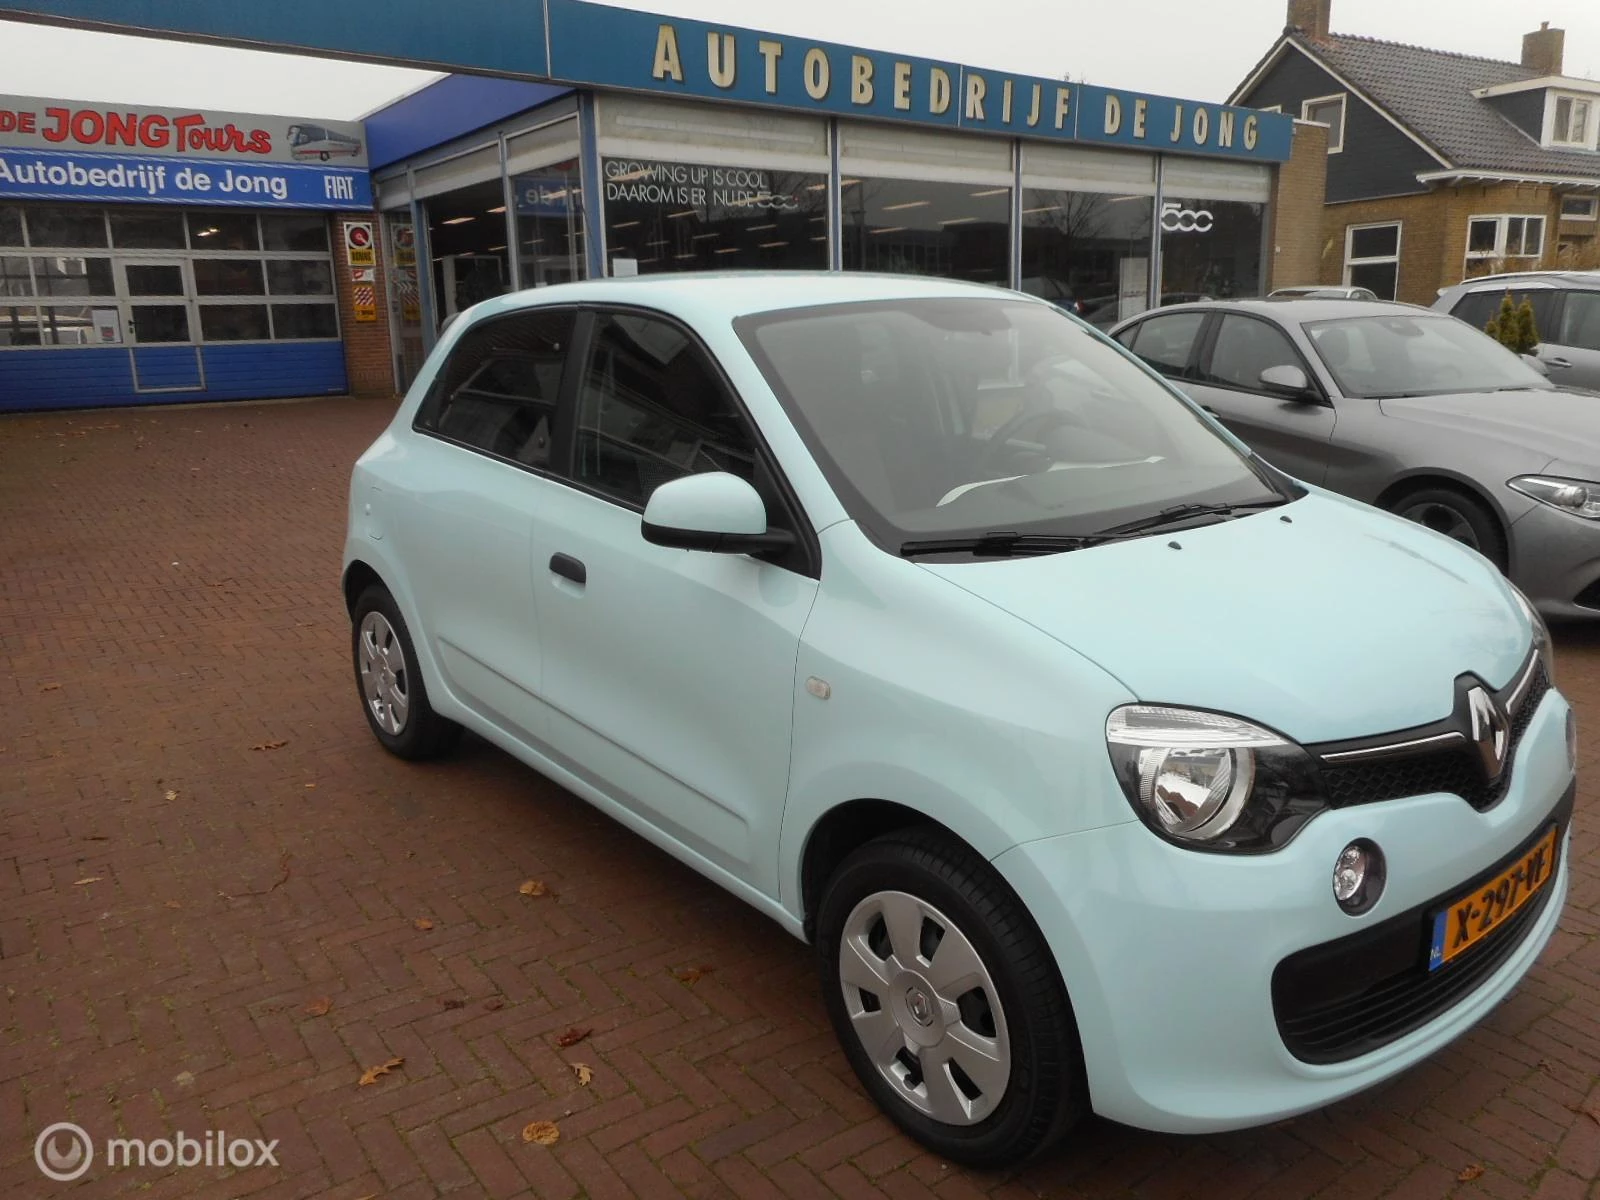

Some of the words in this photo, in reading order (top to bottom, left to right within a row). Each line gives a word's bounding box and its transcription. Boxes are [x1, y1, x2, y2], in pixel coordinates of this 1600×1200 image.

[651, 23, 1072, 130] AUTOBEDRIJF
[1104, 93, 1147, 138] DE
[1169, 105, 1258, 151] JONG
[0, 110, 36, 134] DE
[0, 158, 166, 195] Autobedrijf
[175, 167, 211, 192] de
[218, 168, 287, 200] Jong
[323, 174, 354, 200] FIAT
[605, 160, 687, 183] GROWING
[691, 167, 709, 185] UP
[712, 169, 724, 186] IS
[726, 170, 767, 187] COOL
[606, 183, 673, 203] DAAROM
[677, 187, 688, 204] IS
[692, 187, 706, 205] ER
[1161, 202, 1214, 232] 500
[1453, 841, 1550, 948] X-297-VF
[1429, 946, 1442, 962] NL
